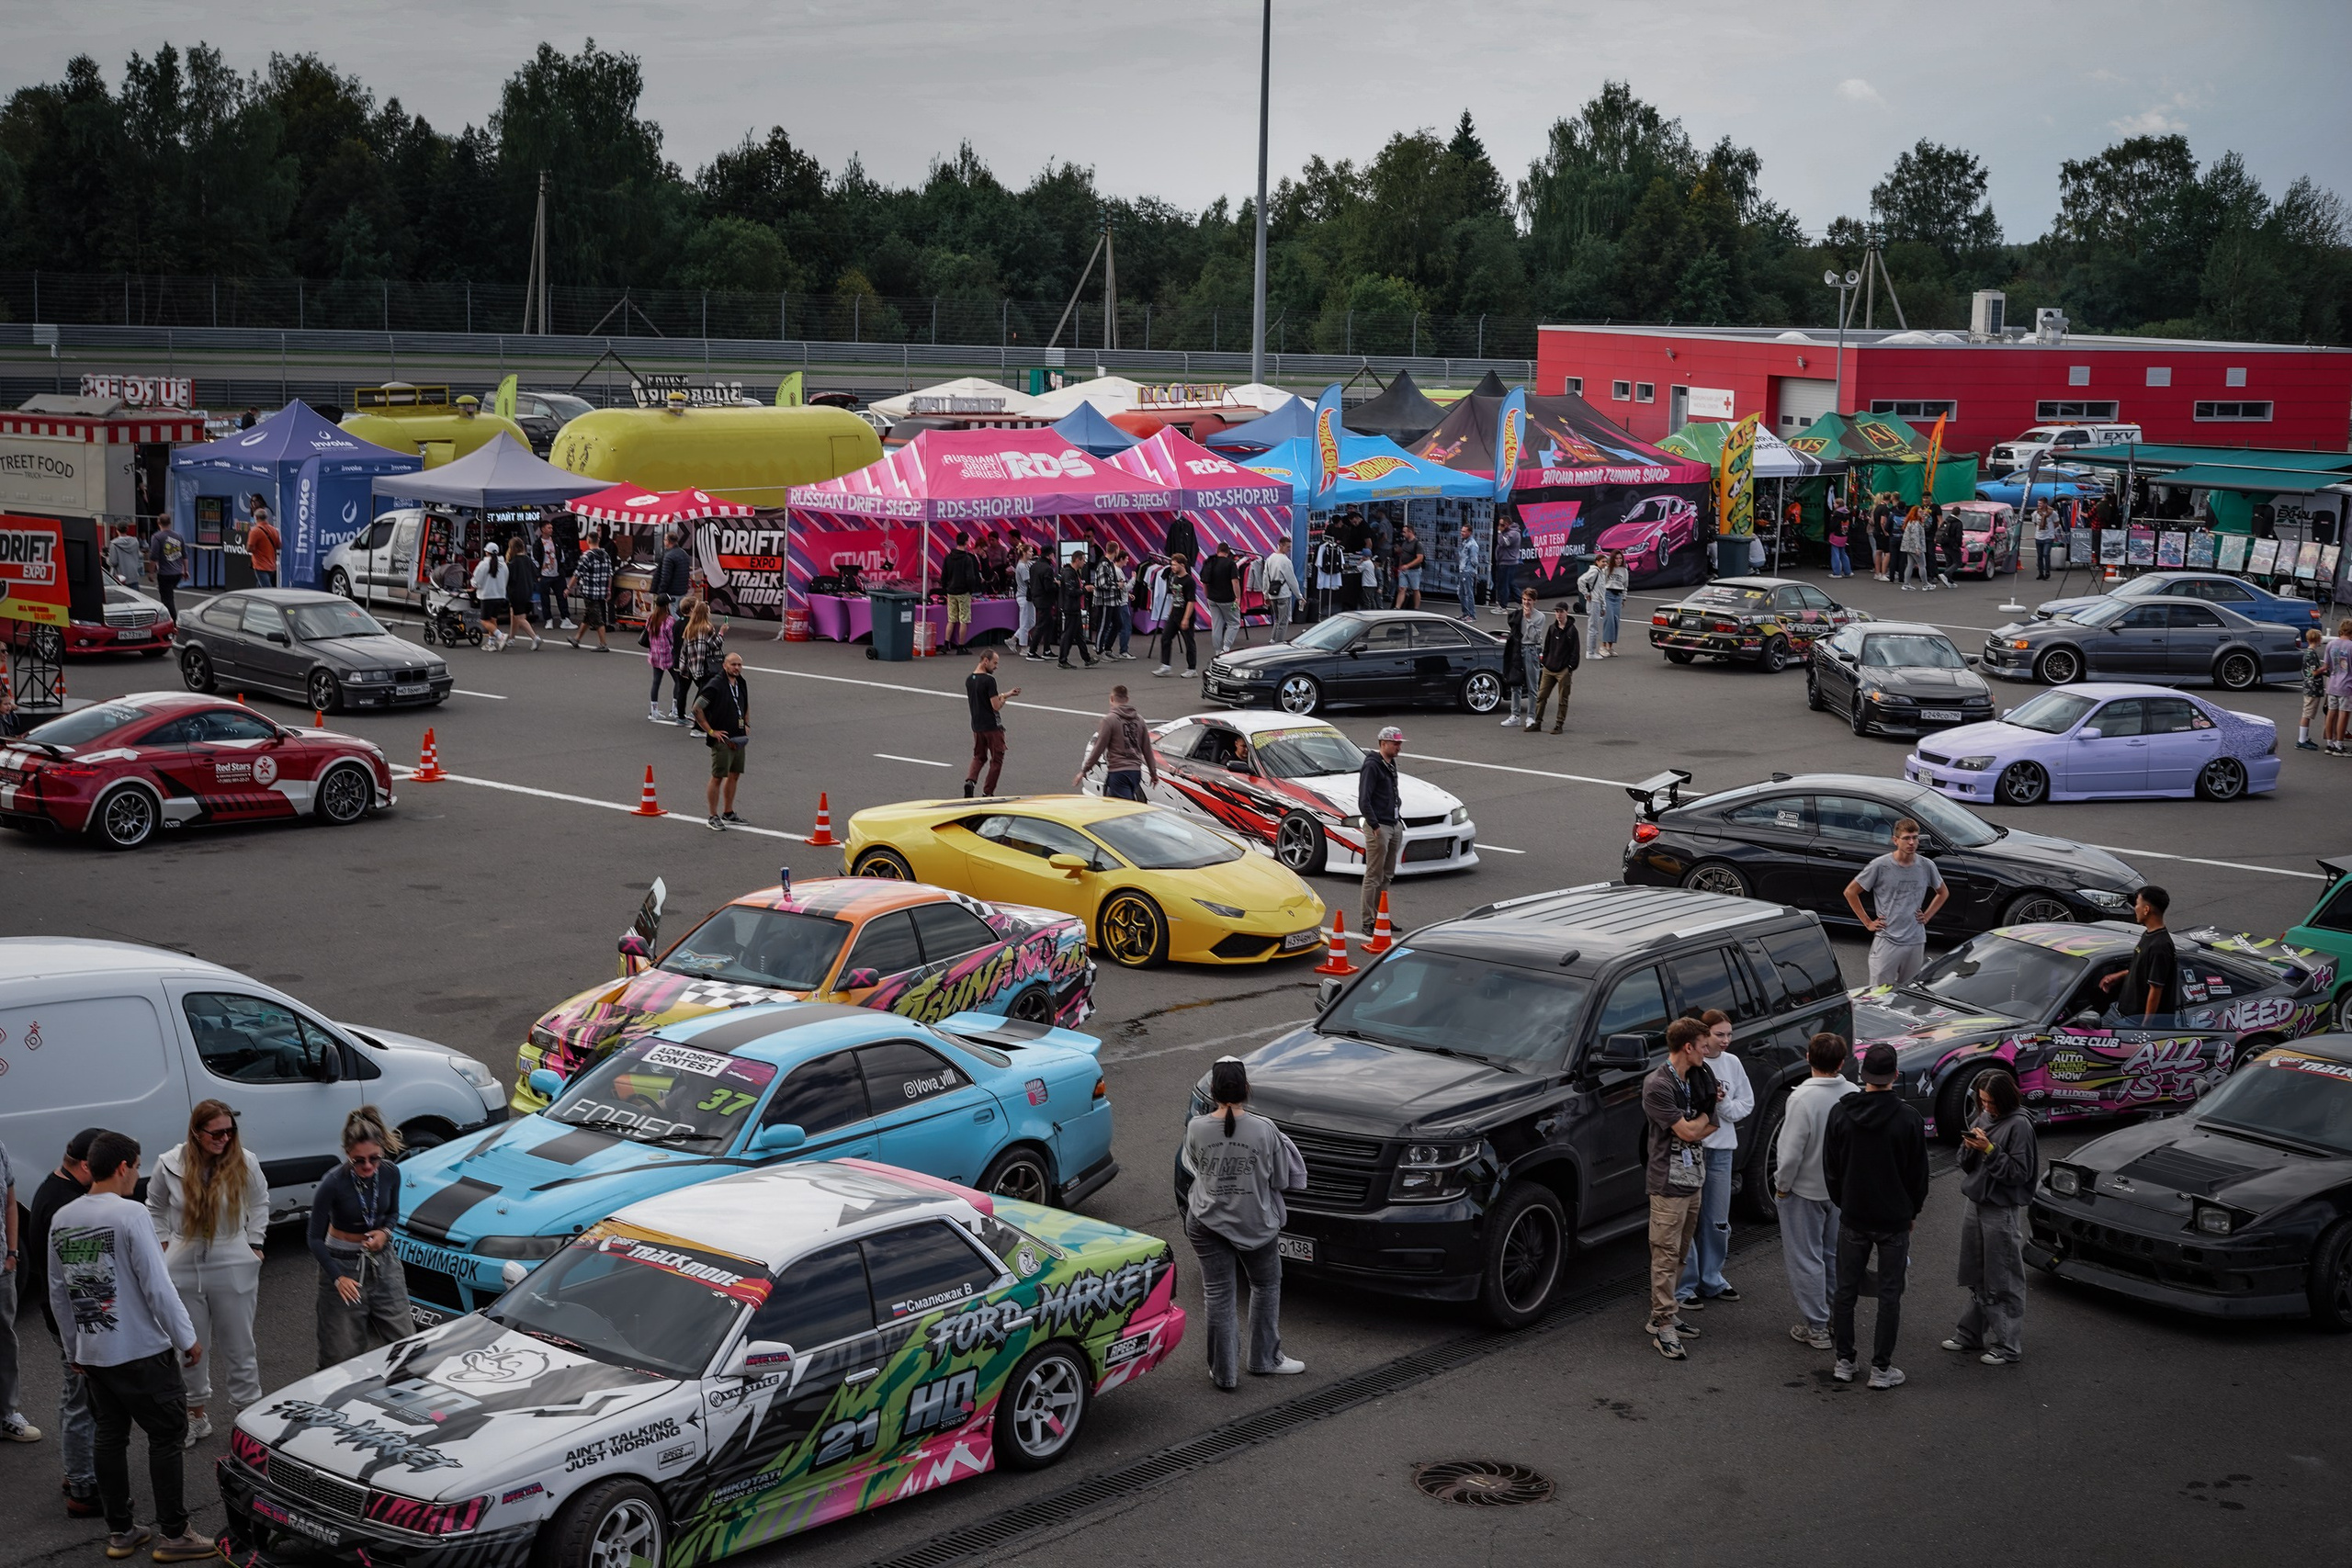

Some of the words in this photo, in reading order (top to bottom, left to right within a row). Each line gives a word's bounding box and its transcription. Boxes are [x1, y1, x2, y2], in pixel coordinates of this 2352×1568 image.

[2104, 432, 2135, 441] EXV
[38, 456, 74, 479] FOOD
[943, 454, 994, 465] RUSSIAN
[967, 462, 998, 471] DRIFT
[1000, 448, 1096, 479] RDS
[1184, 458, 1238, 475] RDS
[962, 469, 1001, 479] SERIES
[1642, 468, 1670, 483] SHOP
[790, 490, 844, 511] RUSSIAN
[848, 495, 883, 514] DRIFT
[886, 499, 922, 517] SHOP
[1095, 494, 1129, 509] СТИЛЬ
[1132, 492, 1163, 508] ЗДЕСЬ
[1197, 488, 1279, 508] RDS-SHOP.RU
[936, 497, 1034, 519] RDS-SHOP.RU
[721, 529, 785, 556] DRIFT
[1533, 534, 1547, 547] ДЛЯ
[1549, 533, 1566, 546] ТЕБЯ
[750, 557, 775, 569] EXPO
[23, 566, 47, 580] EXPO
[729, 570, 781, 588] TRACK
[738, 588, 785, 605] MODE
[215, 763, 230, 773] Red
[232, 762, 252, 773] Stars
[2225, 998, 2297, 1032] NEED
[2018, 1032, 2037, 1041] DRIFT
[2053, 1034, 2087, 1046] RACE
[2088, 1036, 2120, 1048] CLUB
[658, 1046, 684, 1060] ADM
[685, 1053, 725, 1066] DRIFT
[2052, 1054, 2084, 1063] AUTO
[2122, 1038, 2202, 1071] ALL
[650, 1054, 718, 1074] CONTEST
[2048, 1061, 2087, 1074] TUNING
[2051, 1072, 2083, 1081] SHOW
[696, 1088, 759, 1117] 37
[2051, 1089, 2100, 1100] BULLDOZER
[1200, 1156, 1258, 1177] GAMES
[1289, 1240, 1309, 1255] 138
[906, 1289, 964, 1314] Смалюжак
[409, 1304, 443, 1327] RIEC
[722, 1387, 742, 1399] VM
[744, 1376, 779, 1393] STYLE
[939, 1415, 967, 1430] STREAM
[565, 1439, 606, 1463] AIN'T
[608, 1417, 674, 1447] TALKING
[816, 1411, 879, 1467] 21
[564, 1450, 607, 1473] JUST
[608, 1426, 682, 1459] WORKING
[711, 1490, 746, 1506] DESIGN
[746, 1478, 780, 1495] STUDIO
[288, 1510, 342, 1548] RACING
